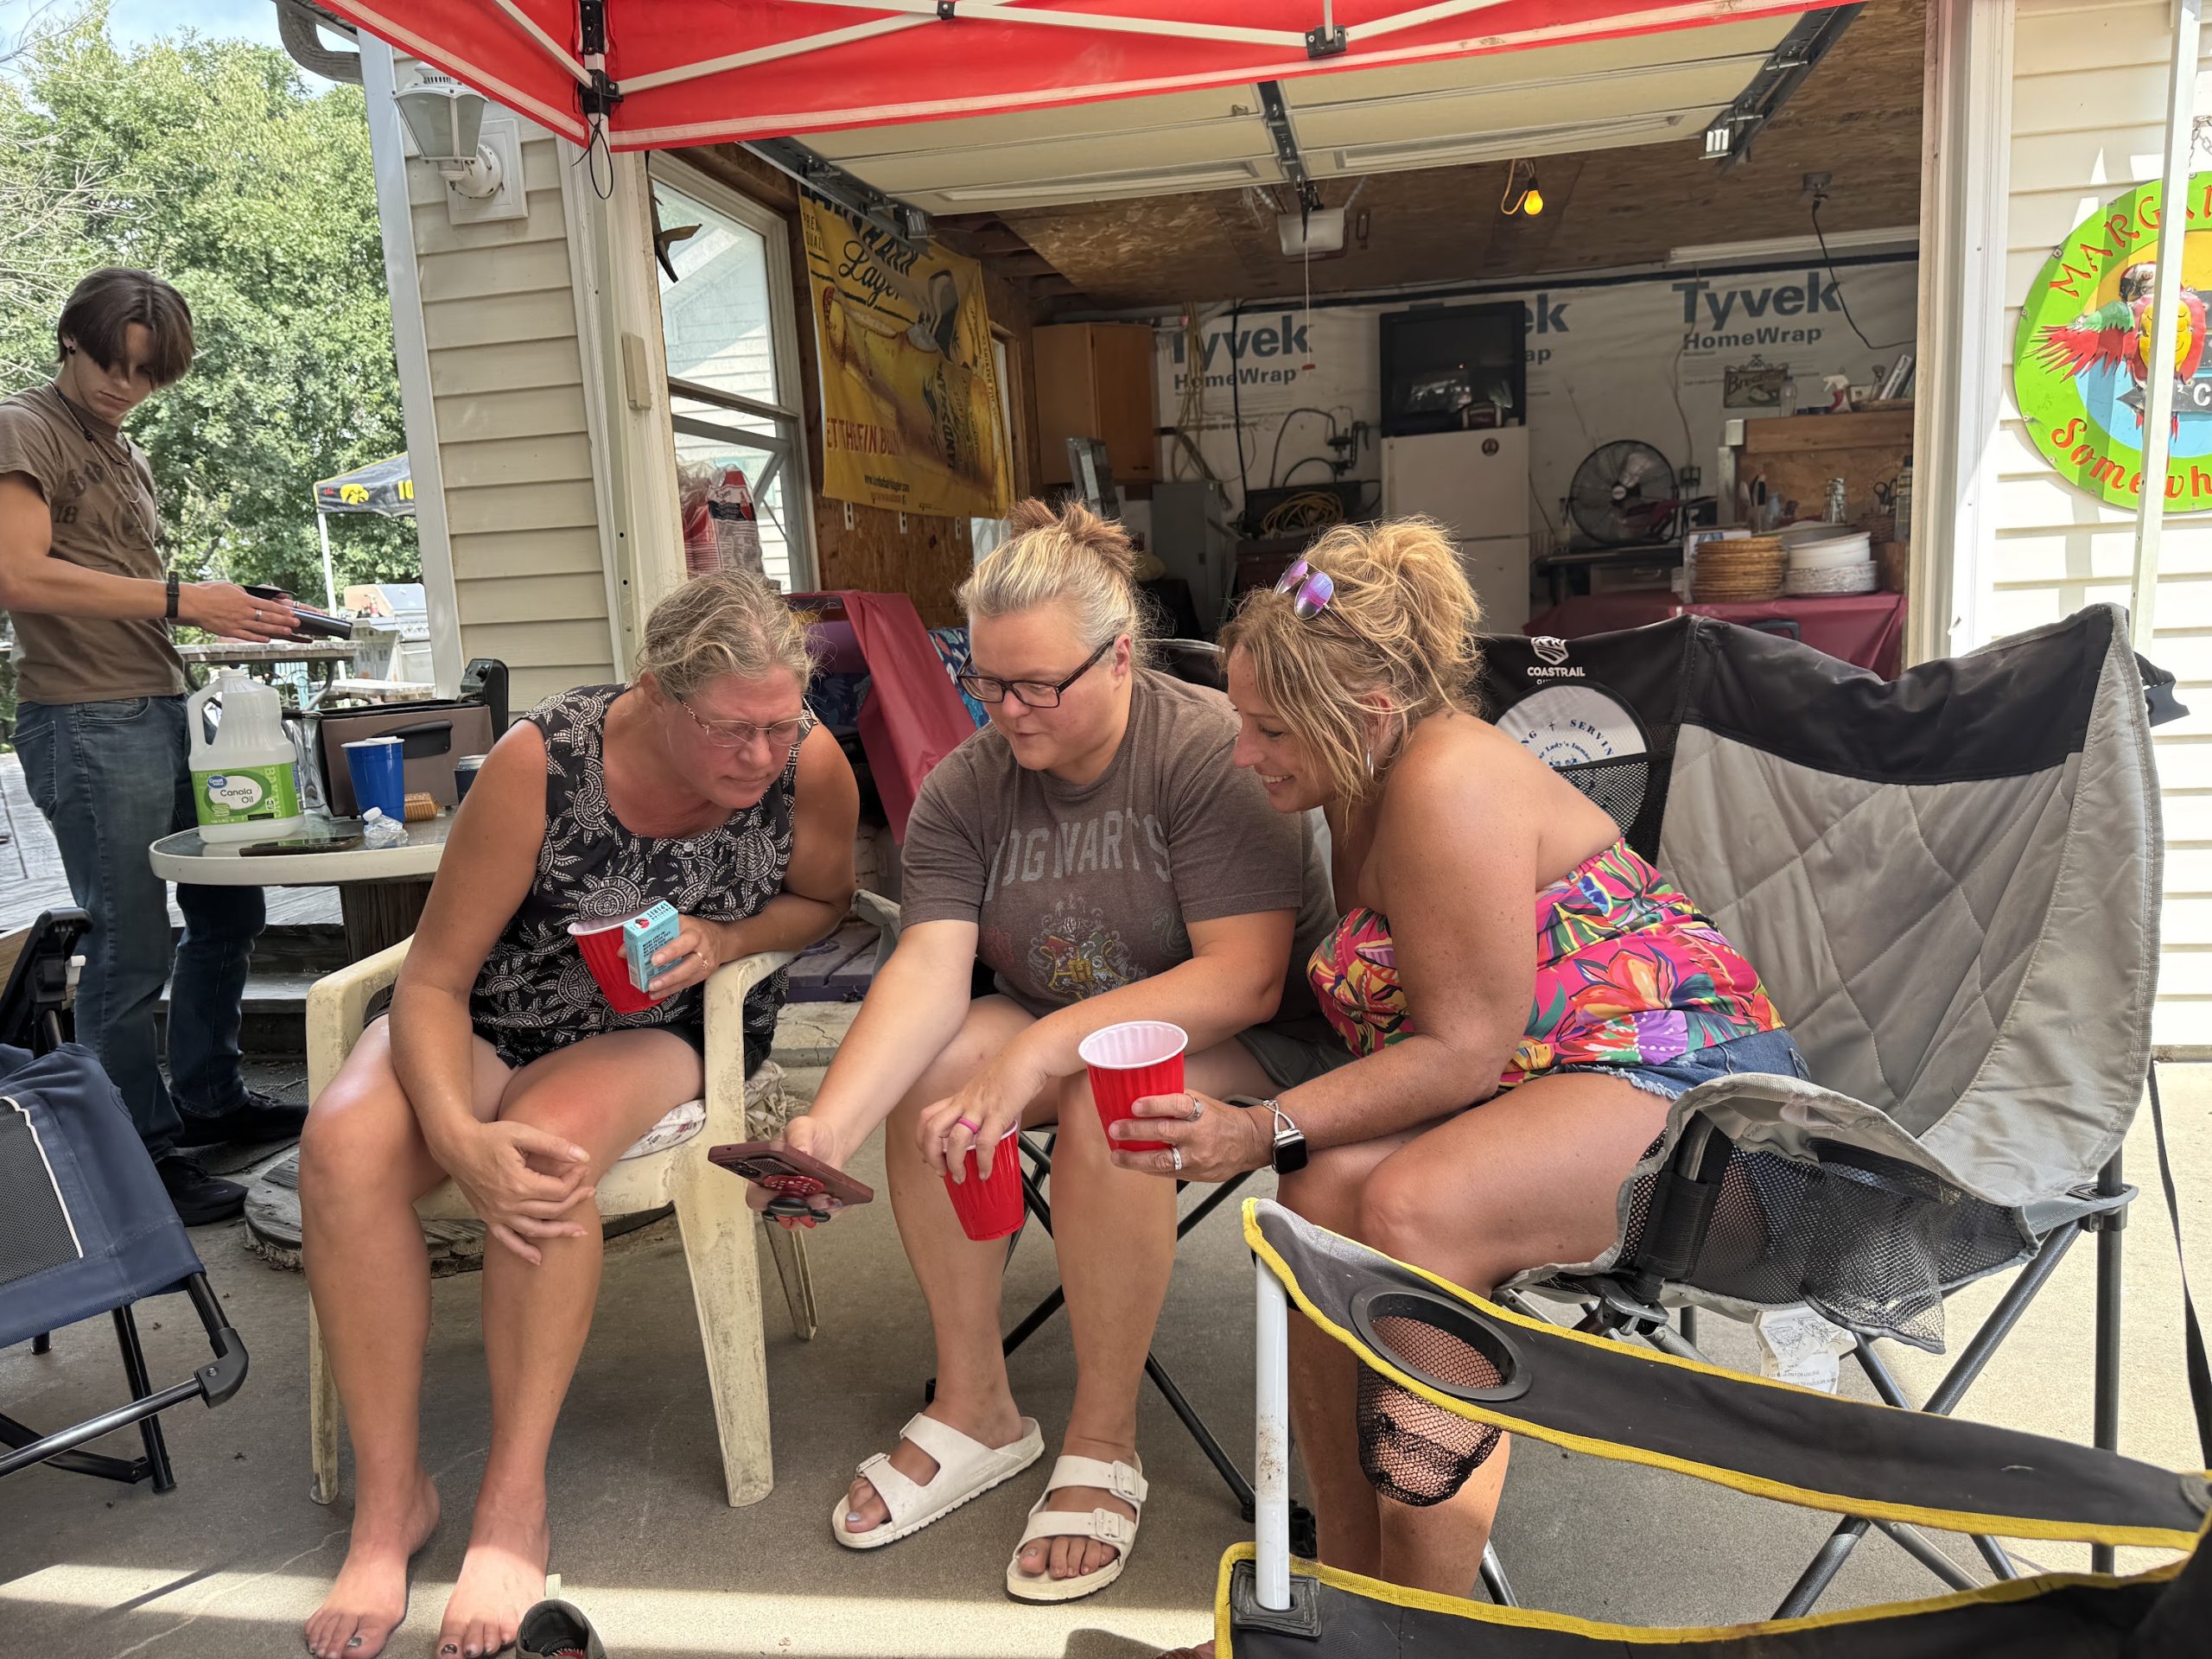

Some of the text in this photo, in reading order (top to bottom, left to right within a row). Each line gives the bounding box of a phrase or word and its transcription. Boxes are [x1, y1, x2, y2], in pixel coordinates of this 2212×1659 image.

[1672, 271, 1843, 332] Tyvek
[1683, 327, 1822, 350] HomeWrap
[1527, 666, 1586, 677] COASTRAIL
[219, 787, 252, 797] Canola
